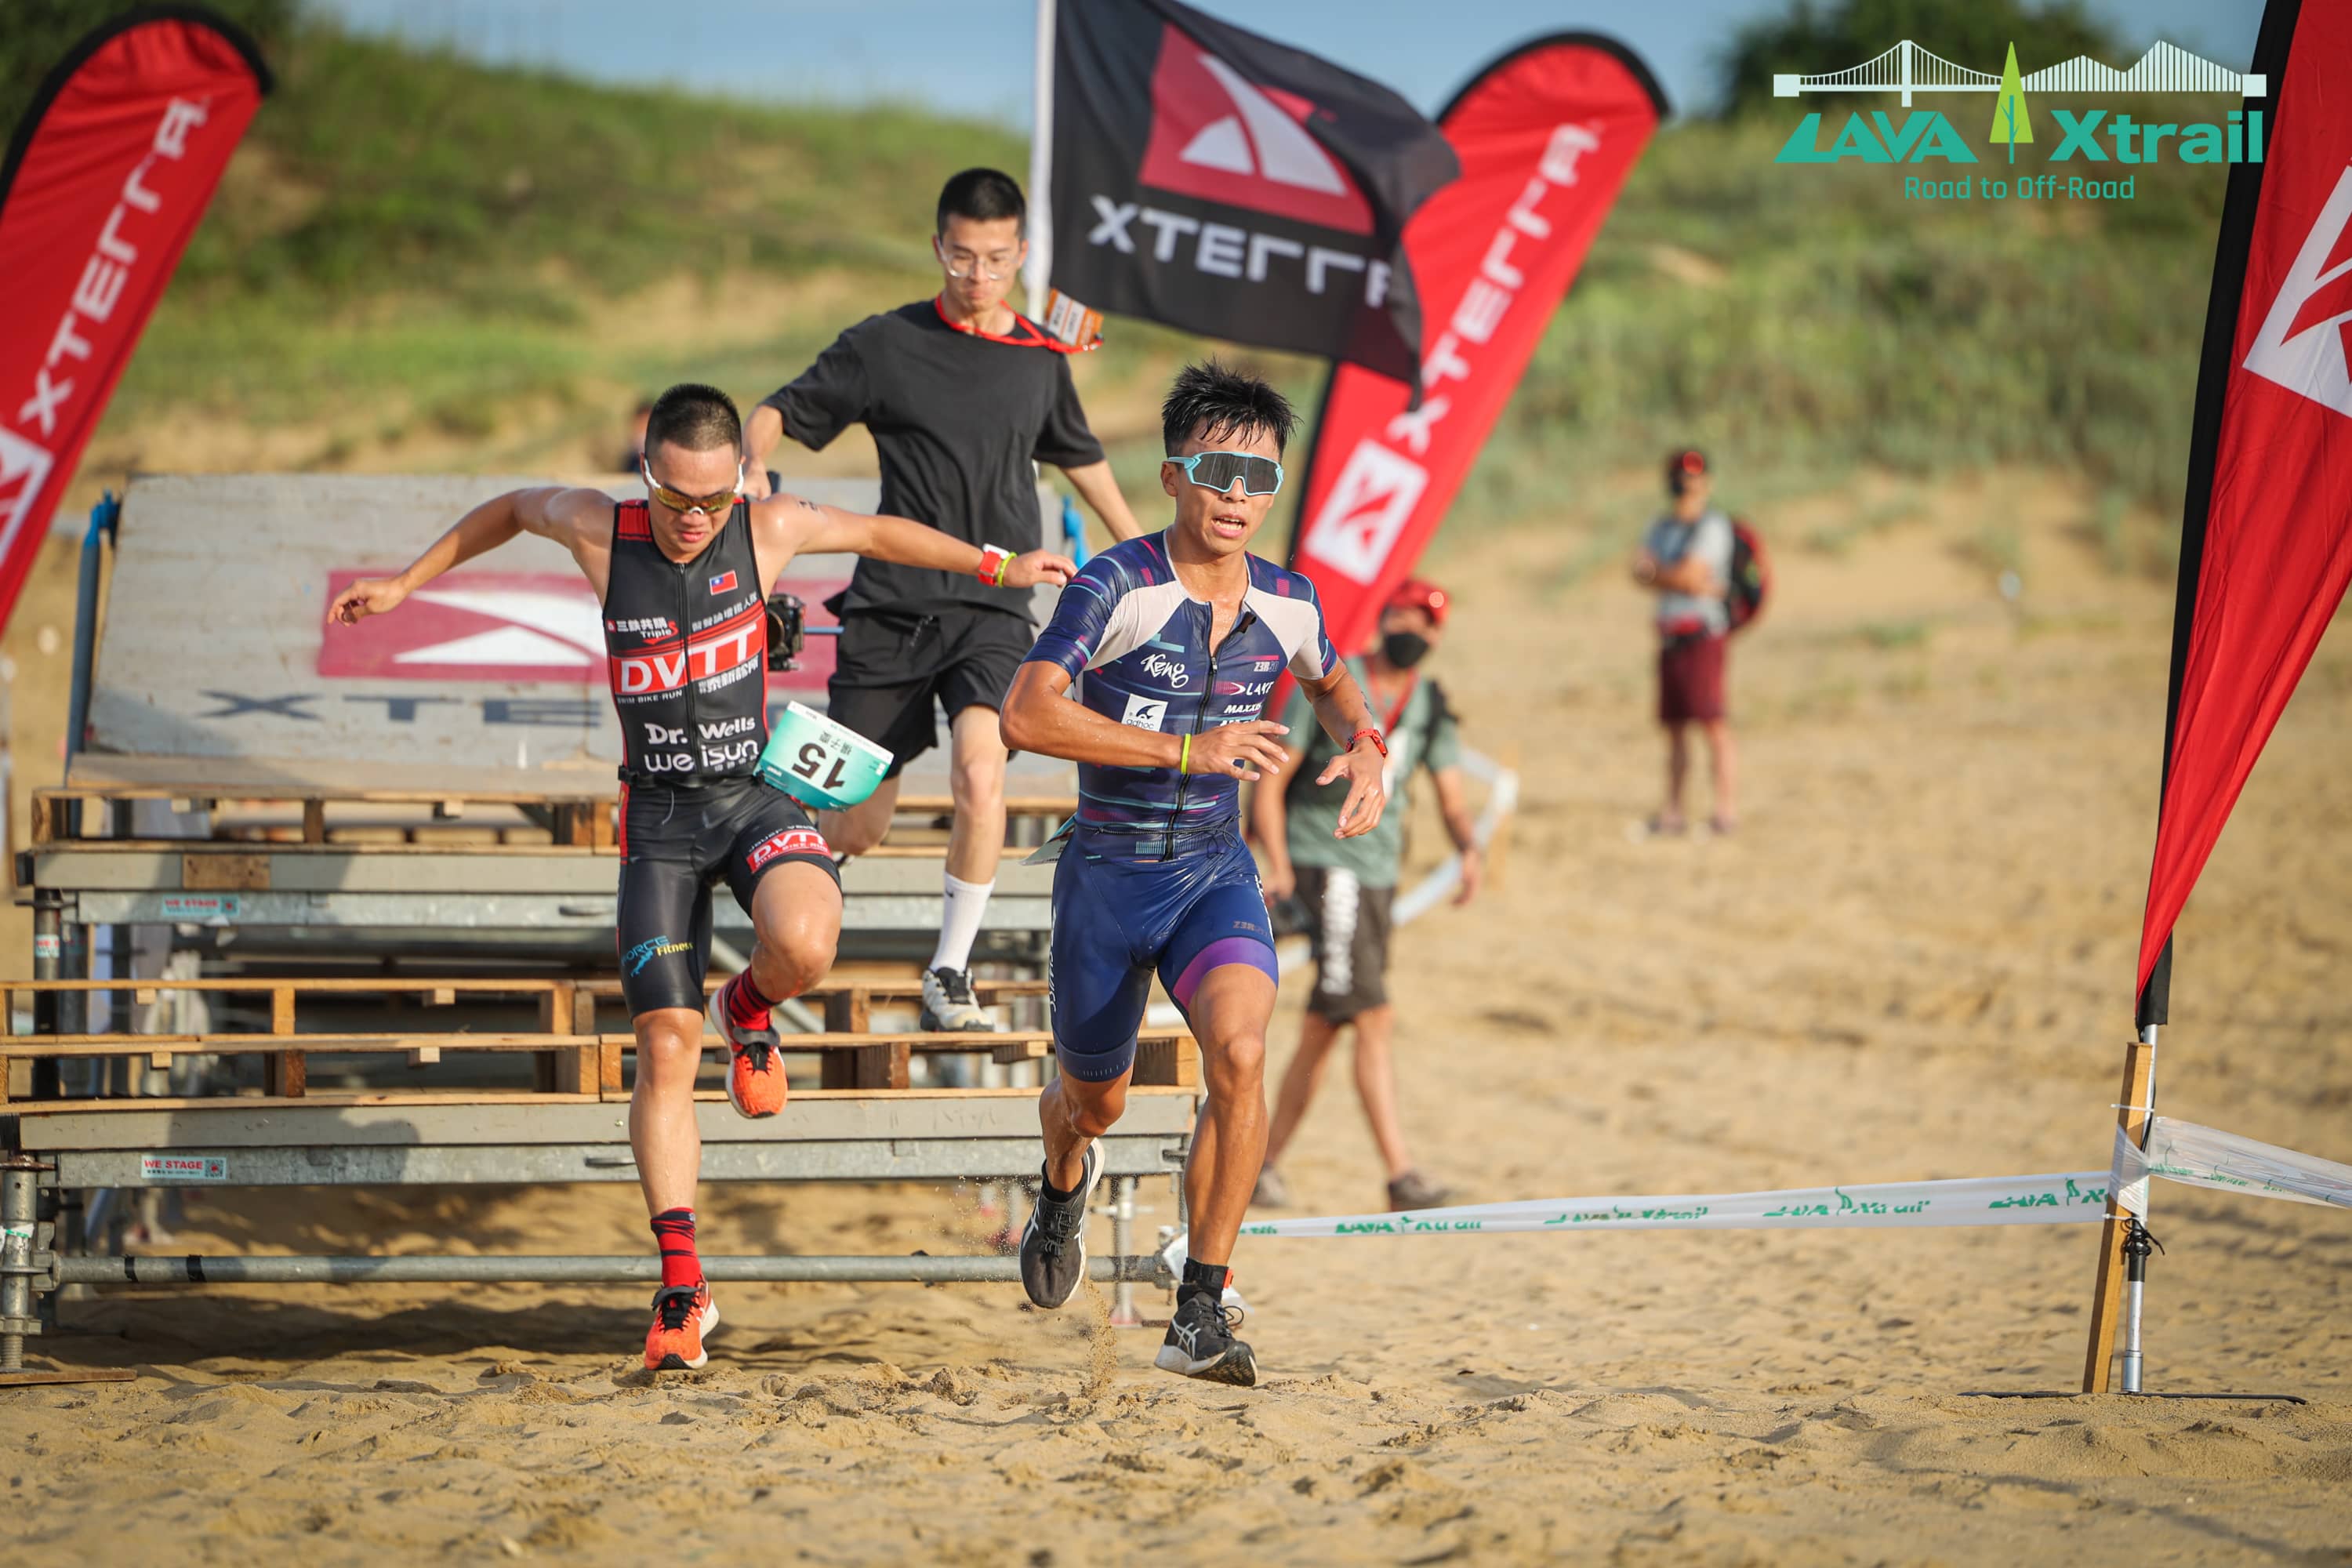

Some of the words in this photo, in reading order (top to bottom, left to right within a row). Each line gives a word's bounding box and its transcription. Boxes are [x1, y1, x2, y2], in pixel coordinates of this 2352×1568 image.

[19, 96, 209, 437] XTERRA
[1385, 123, 1600, 455] XTERRA
[620, 622, 757, 692] DVTT
[637, 694, 659, 703] BIKE
[662, 690, 684, 701] RUN
[644, 722, 689, 745] Dr.
[698, 717, 756, 740] Wells
[792, 742, 846, 789] 15
[753, 831, 825, 864] DVTT
[144, 1160, 162, 1169] WE
[165, 1160, 203, 1170] STAGE
